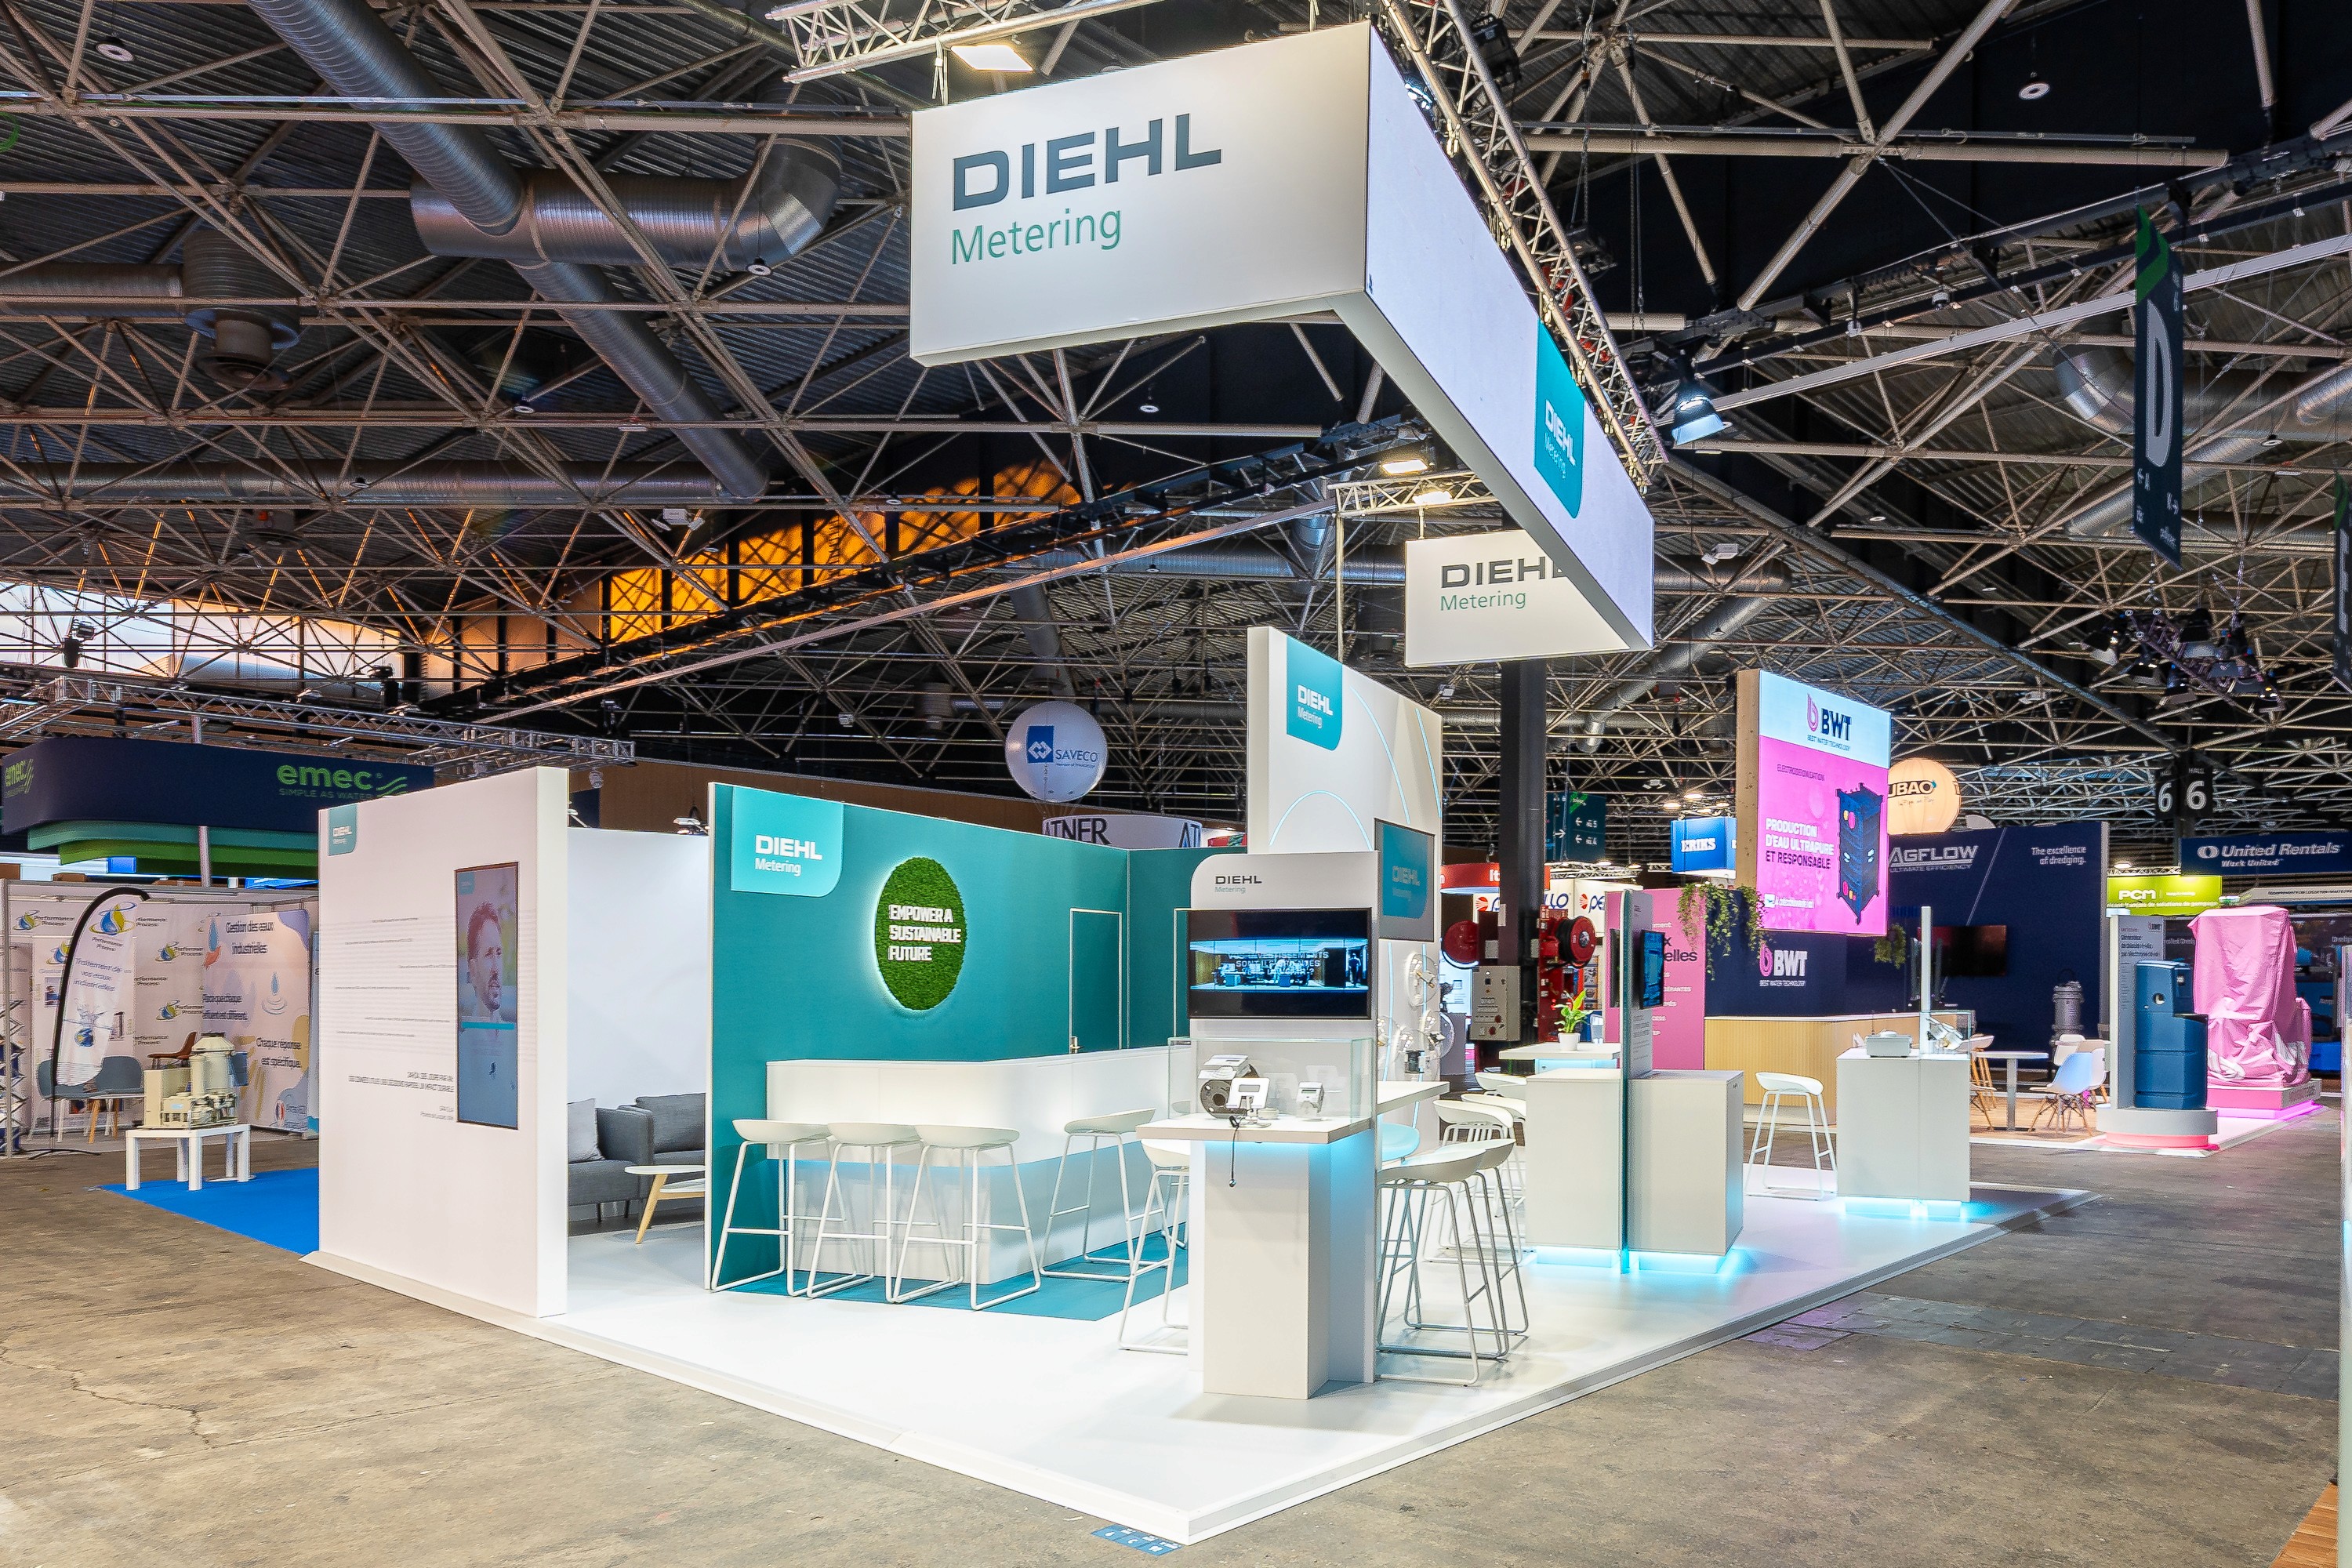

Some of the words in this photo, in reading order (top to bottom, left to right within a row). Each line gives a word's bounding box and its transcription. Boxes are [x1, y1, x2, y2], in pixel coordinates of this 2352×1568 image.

[952, 113, 1222, 211] DIEHL
[951, 207, 1122, 265] Metering
[2146, 299, 2172, 467] D
[1545, 399, 1576, 466] DIEHL
[1440, 591, 1526, 611] Metering
[1298, 684, 1334, 716] DIEHL
[1297, 706, 1323, 729] Metering
[1821, 708, 1852, 741] BWT
[1055, 749, 1098, 762] SAVECO
[277, 764, 373, 789] emec
[279, 788, 317, 797] SIMPLE
[1888, 780, 1932, 798] UBAO
[2158, 782, 2172, 812] 6
[2187, 780, 2206, 810] 6
[1766, 818, 1817, 837] PRODUCTION
[755, 834, 822, 861] DIEHL
[1681, 838, 1717, 852] ERIKS
[1766, 834, 1789, 848] D'EAU
[1791, 838, 1834, 855] ULTRAPURE
[2031, 847, 2045, 855] The
[2047, 845, 2086, 855] excellence
[2222, 844, 2277, 857] United
[2278, 842, 2341, 855] Rentals
[1766, 851, 1776, 862] ET
[1777, 852, 1831, 869] RESPONSABLE
[1888, 846, 1979, 864] AGFLOW
[2040, 856, 2049, 865] of
[755, 858, 801, 877] Metering
[1215, 875, 1262, 884] DIEHL
[2118, 889, 2156, 901] PCM
[888, 904, 943, 923] EMPOWER
[943, 908, 954, 923] A
[226, 920, 247, 933] Gestion
[260, 921, 274, 931] eaux
[889, 924, 961, 943] SUSTAINABLE
[232, 942, 268, 954] industrielles
[887, 946, 932, 961] FUTURE
[1664, 949, 1697, 961] elles
[74, 958, 112, 971] Traitement
[1773, 950, 1807, 976] BWT
[73, 978, 115, 992] industrielles
[256, 1037, 277, 1050] Chaque
[278, 1039, 301, 1051] réponse
